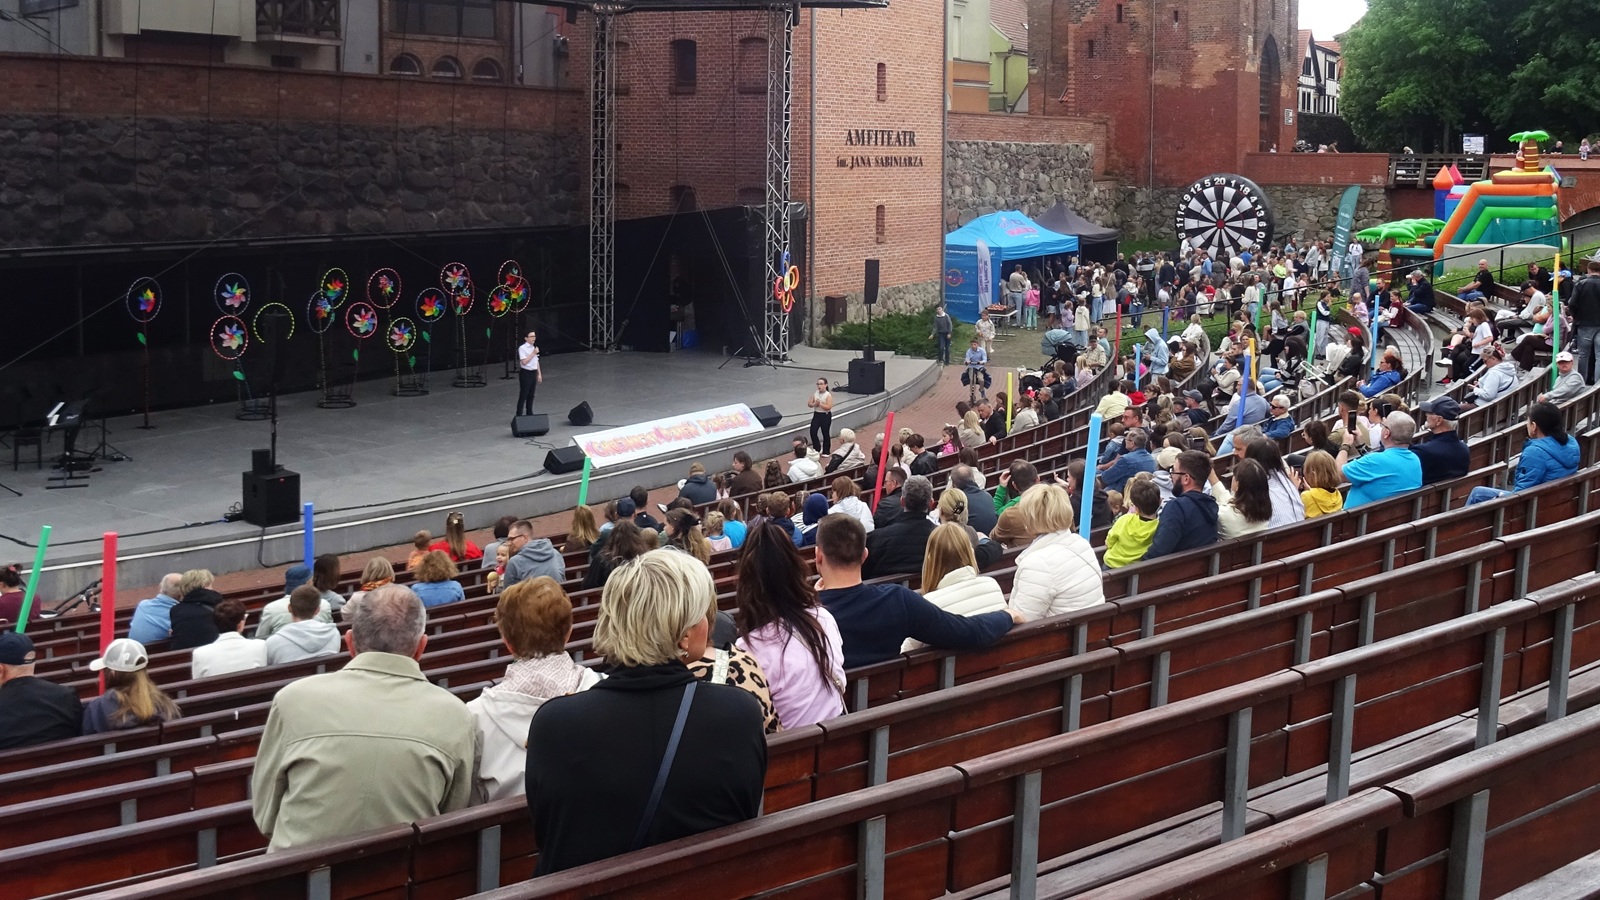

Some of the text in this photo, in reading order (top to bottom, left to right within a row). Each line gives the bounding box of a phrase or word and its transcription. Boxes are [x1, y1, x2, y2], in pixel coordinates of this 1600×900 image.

[845, 129, 916, 146] AMFITEATR
[850, 156, 872, 169] JANA
[874, 156, 923, 168] SABINIARZA
[1213, 177, 1226, 186] 20
[1190, 183, 1202, 195] 12
[1239, 184, 1251, 195] 18
[1183, 194, 1191, 202] 9
[1177, 203, 1187, 216] 14
[1254, 204, 1265, 217] 13
[1176, 217, 1184, 228] 11
